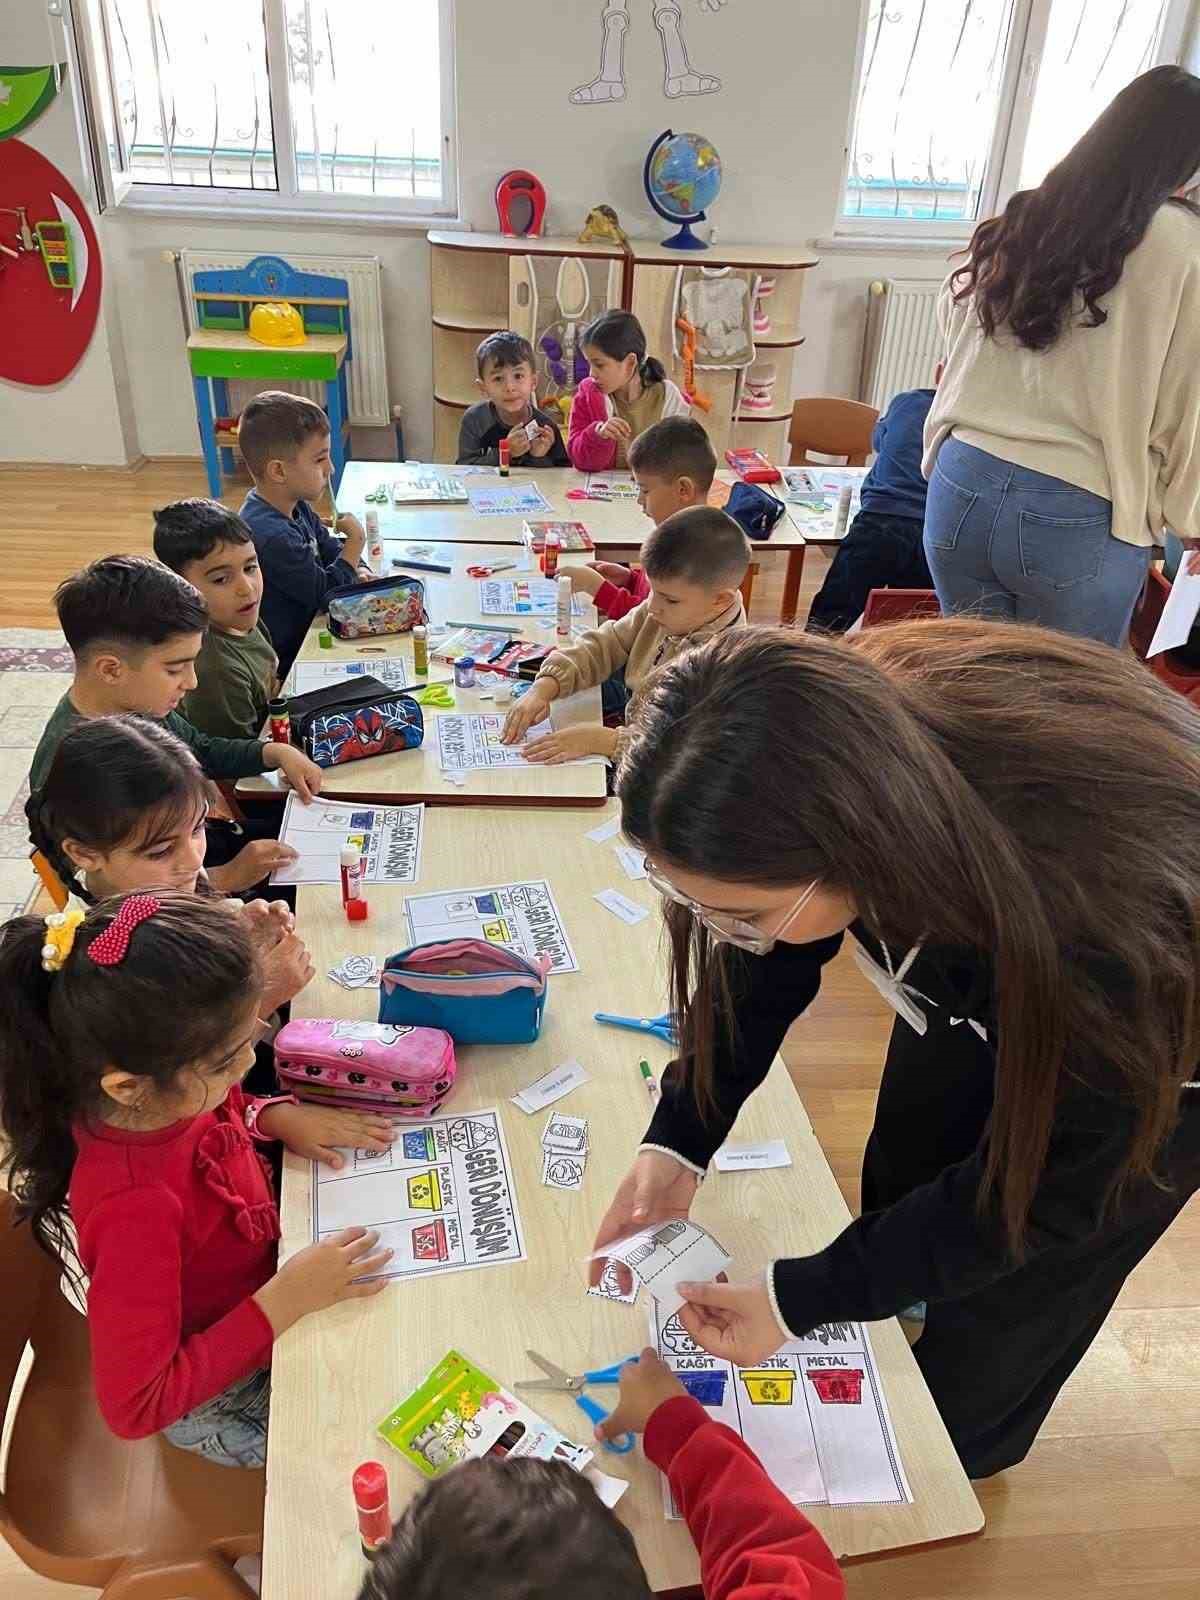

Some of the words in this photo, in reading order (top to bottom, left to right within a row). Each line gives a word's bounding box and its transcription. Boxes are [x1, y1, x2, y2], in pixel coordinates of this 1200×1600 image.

[465, 1148, 503, 1182] GERİ
[447, 1218, 460, 1250] METAL
[469, 1181, 512, 1258] DÖNÜŞÜM
[676, 1356, 715, 1368] KAĞIT
[807, 1357, 848, 1367] METAL
